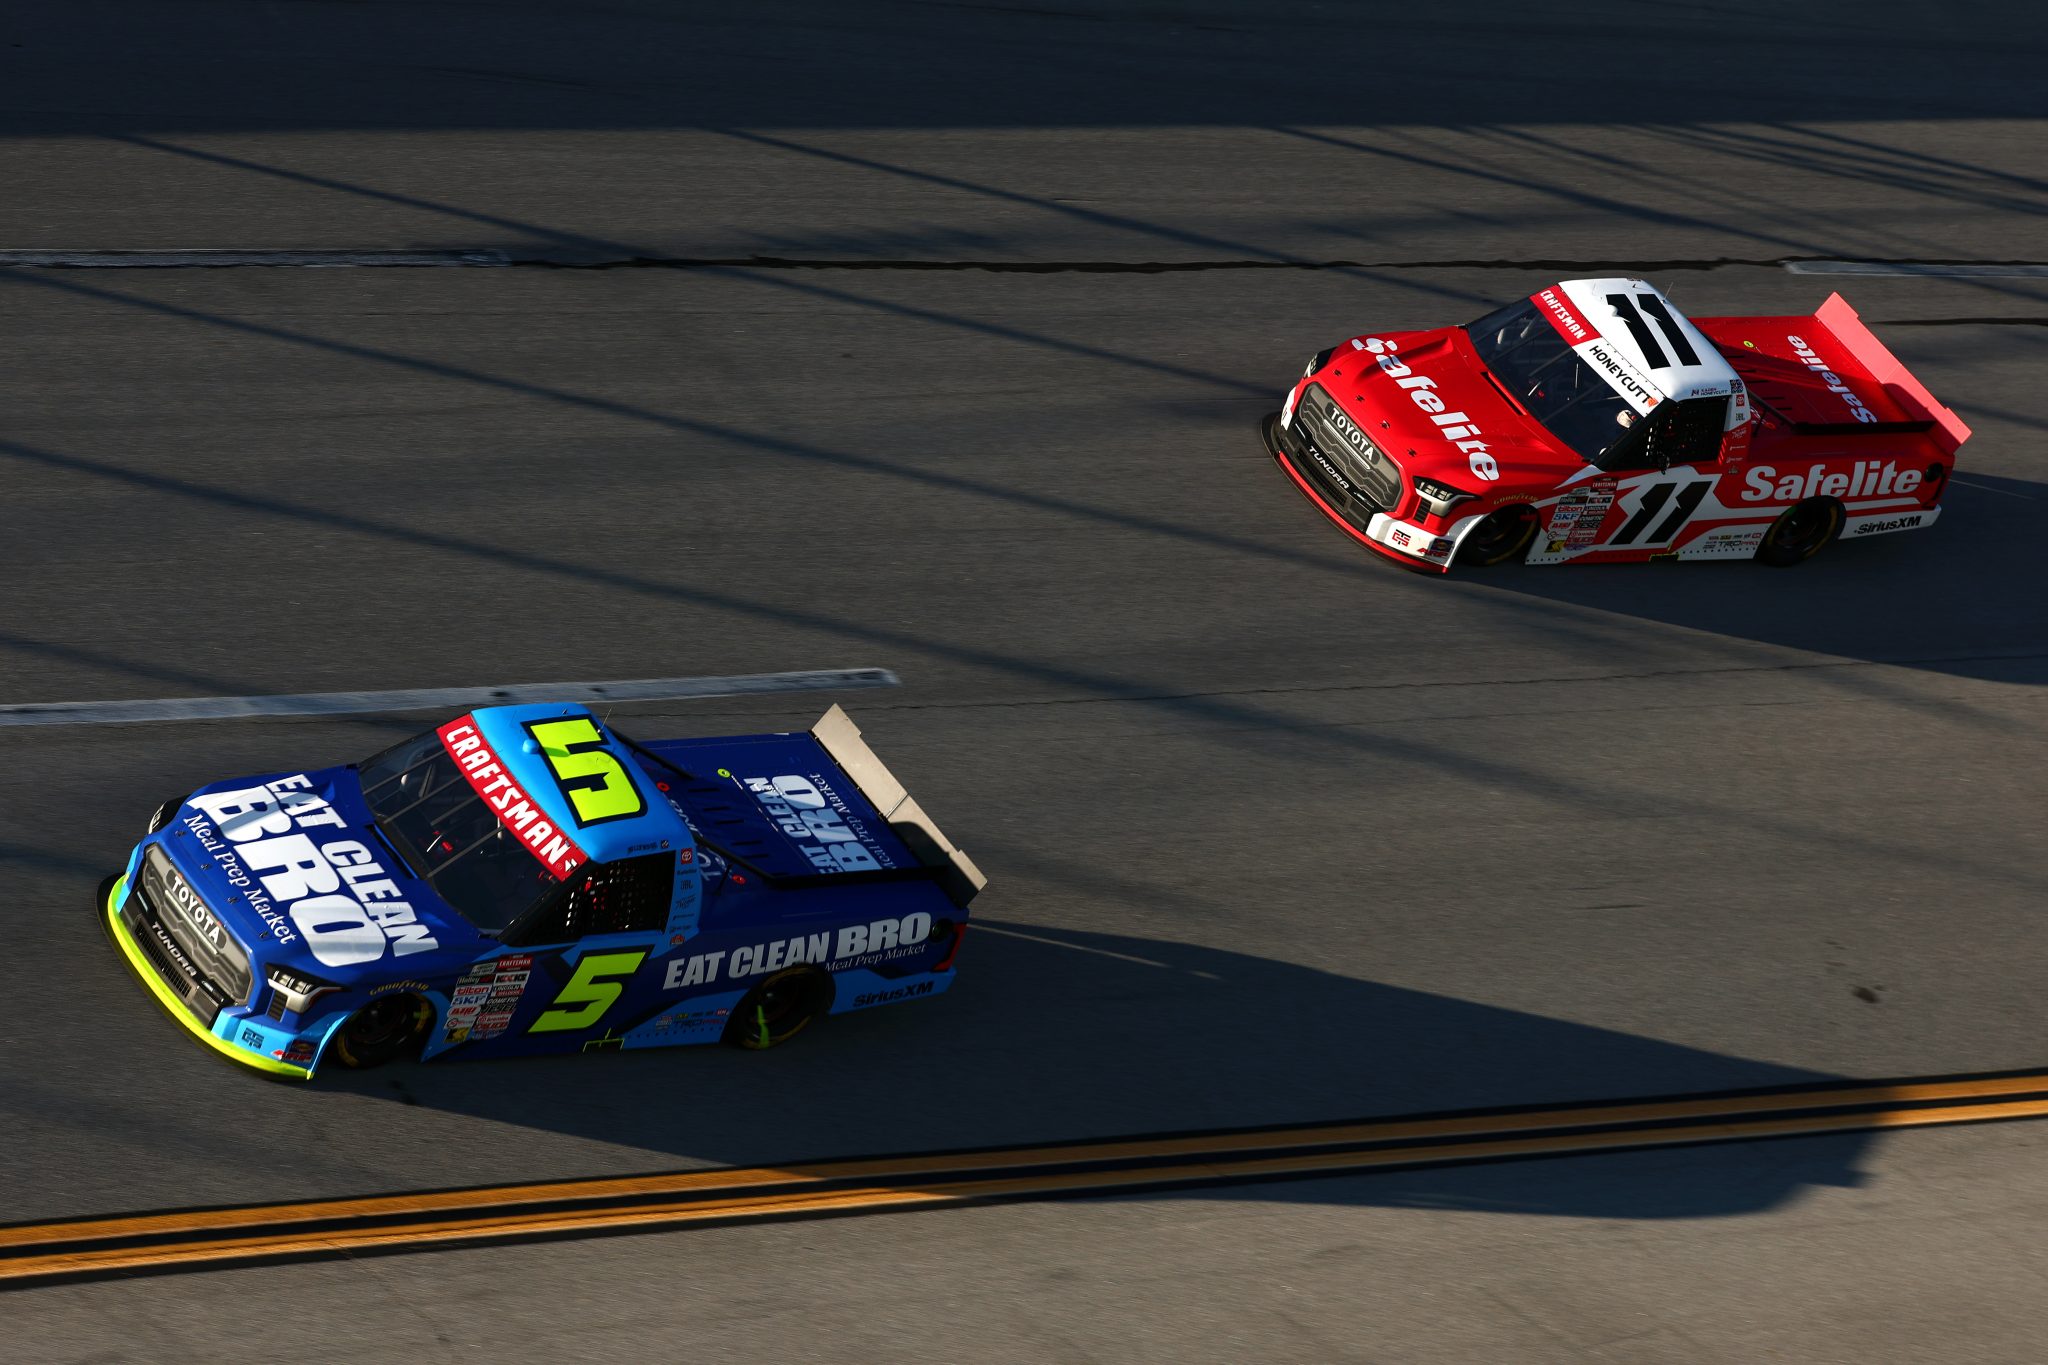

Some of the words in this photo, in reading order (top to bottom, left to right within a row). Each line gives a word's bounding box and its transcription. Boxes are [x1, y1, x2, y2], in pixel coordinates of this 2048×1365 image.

[1540, 290, 1586, 339] CRAFTSMAN
[1605, 294, 1702, 369] 11
[1589, 345, 1652, 404] HONEYCUTT
[1787, 335, 1878, 424] Safelite
[1331, 408, 1373, 460] TOYOTA
[1352, 338, 1500, 481] Safelite
[1309, 445, 1350, 489] TUNDRA
[1741, 460, 1922, 501] Safelite
[1609, 482, 1713, 545] 11
[1857, 515, 1921, 534] SiriusXM
[446, 725, 571, 865] CRAFTSMAN
[528, 717, 642, 824] 5
[743, 777, 811, 838] CLEAN
[771, 775, 882, 872] BRO
[183, 814, 226, 852] Meal
[213, 851, 250, 887] Prep
[243, 888, 297, 945] Market
[186, 785, 386, 967] BRO
[265, 774, 348, 828] EAT
[321, 840, 439, 957] CLEAN
[172, 875, 221, 943] TOYOTA
[152, 921, 197, 976] TUNDRA
[662, 951, 726, 990] EAT
[728, 931, 830, 979] CLEAN
[835, 912, 932, 959] BRO
[825, 958, 853, 972] Meal
[855, 953, 882, 967] Prep
[885, 943, 928, 960] Market
[452, 996, 486, 1005] SKF
[527, 951, 646, 1033] 5
[853, 981, 934, 1007] SiriusXM
